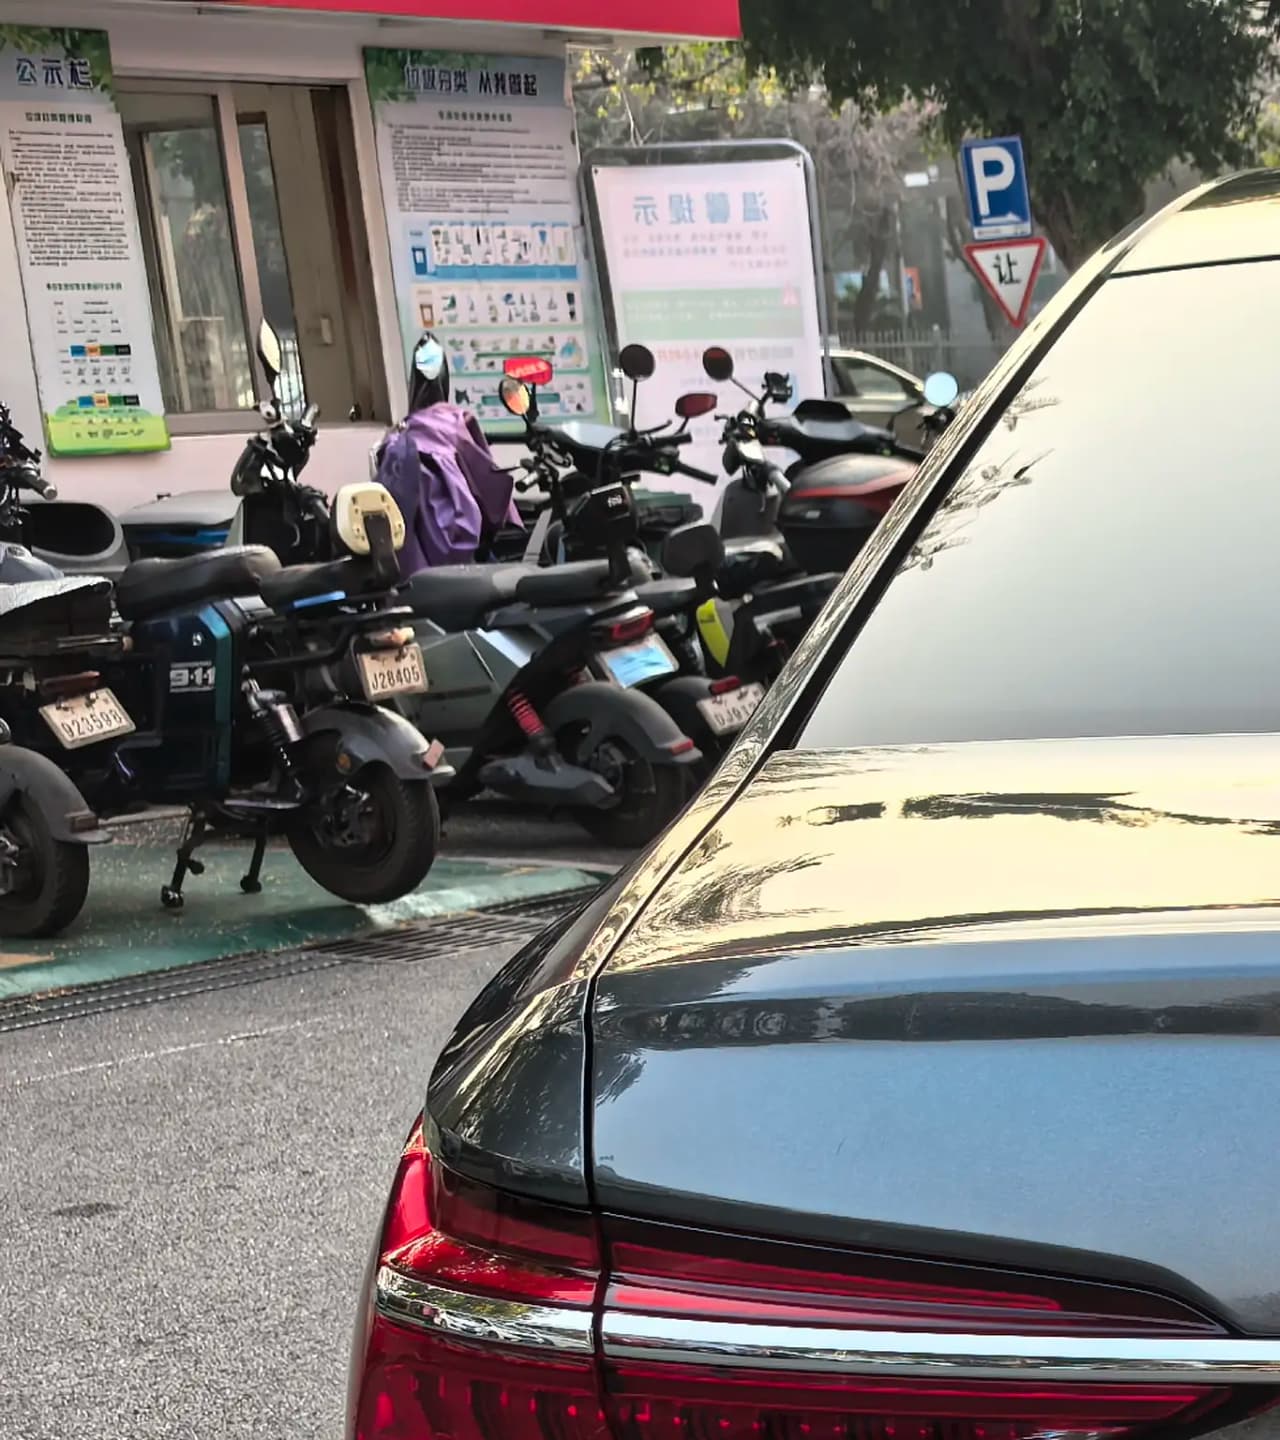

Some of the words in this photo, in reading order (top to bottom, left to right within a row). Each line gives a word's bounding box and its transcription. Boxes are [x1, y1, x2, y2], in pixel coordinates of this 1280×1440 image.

[15, 58, 92, 86] 公示栏
[971, 146, 1015, 216] P
[993, 252, 1021, 284] 让
